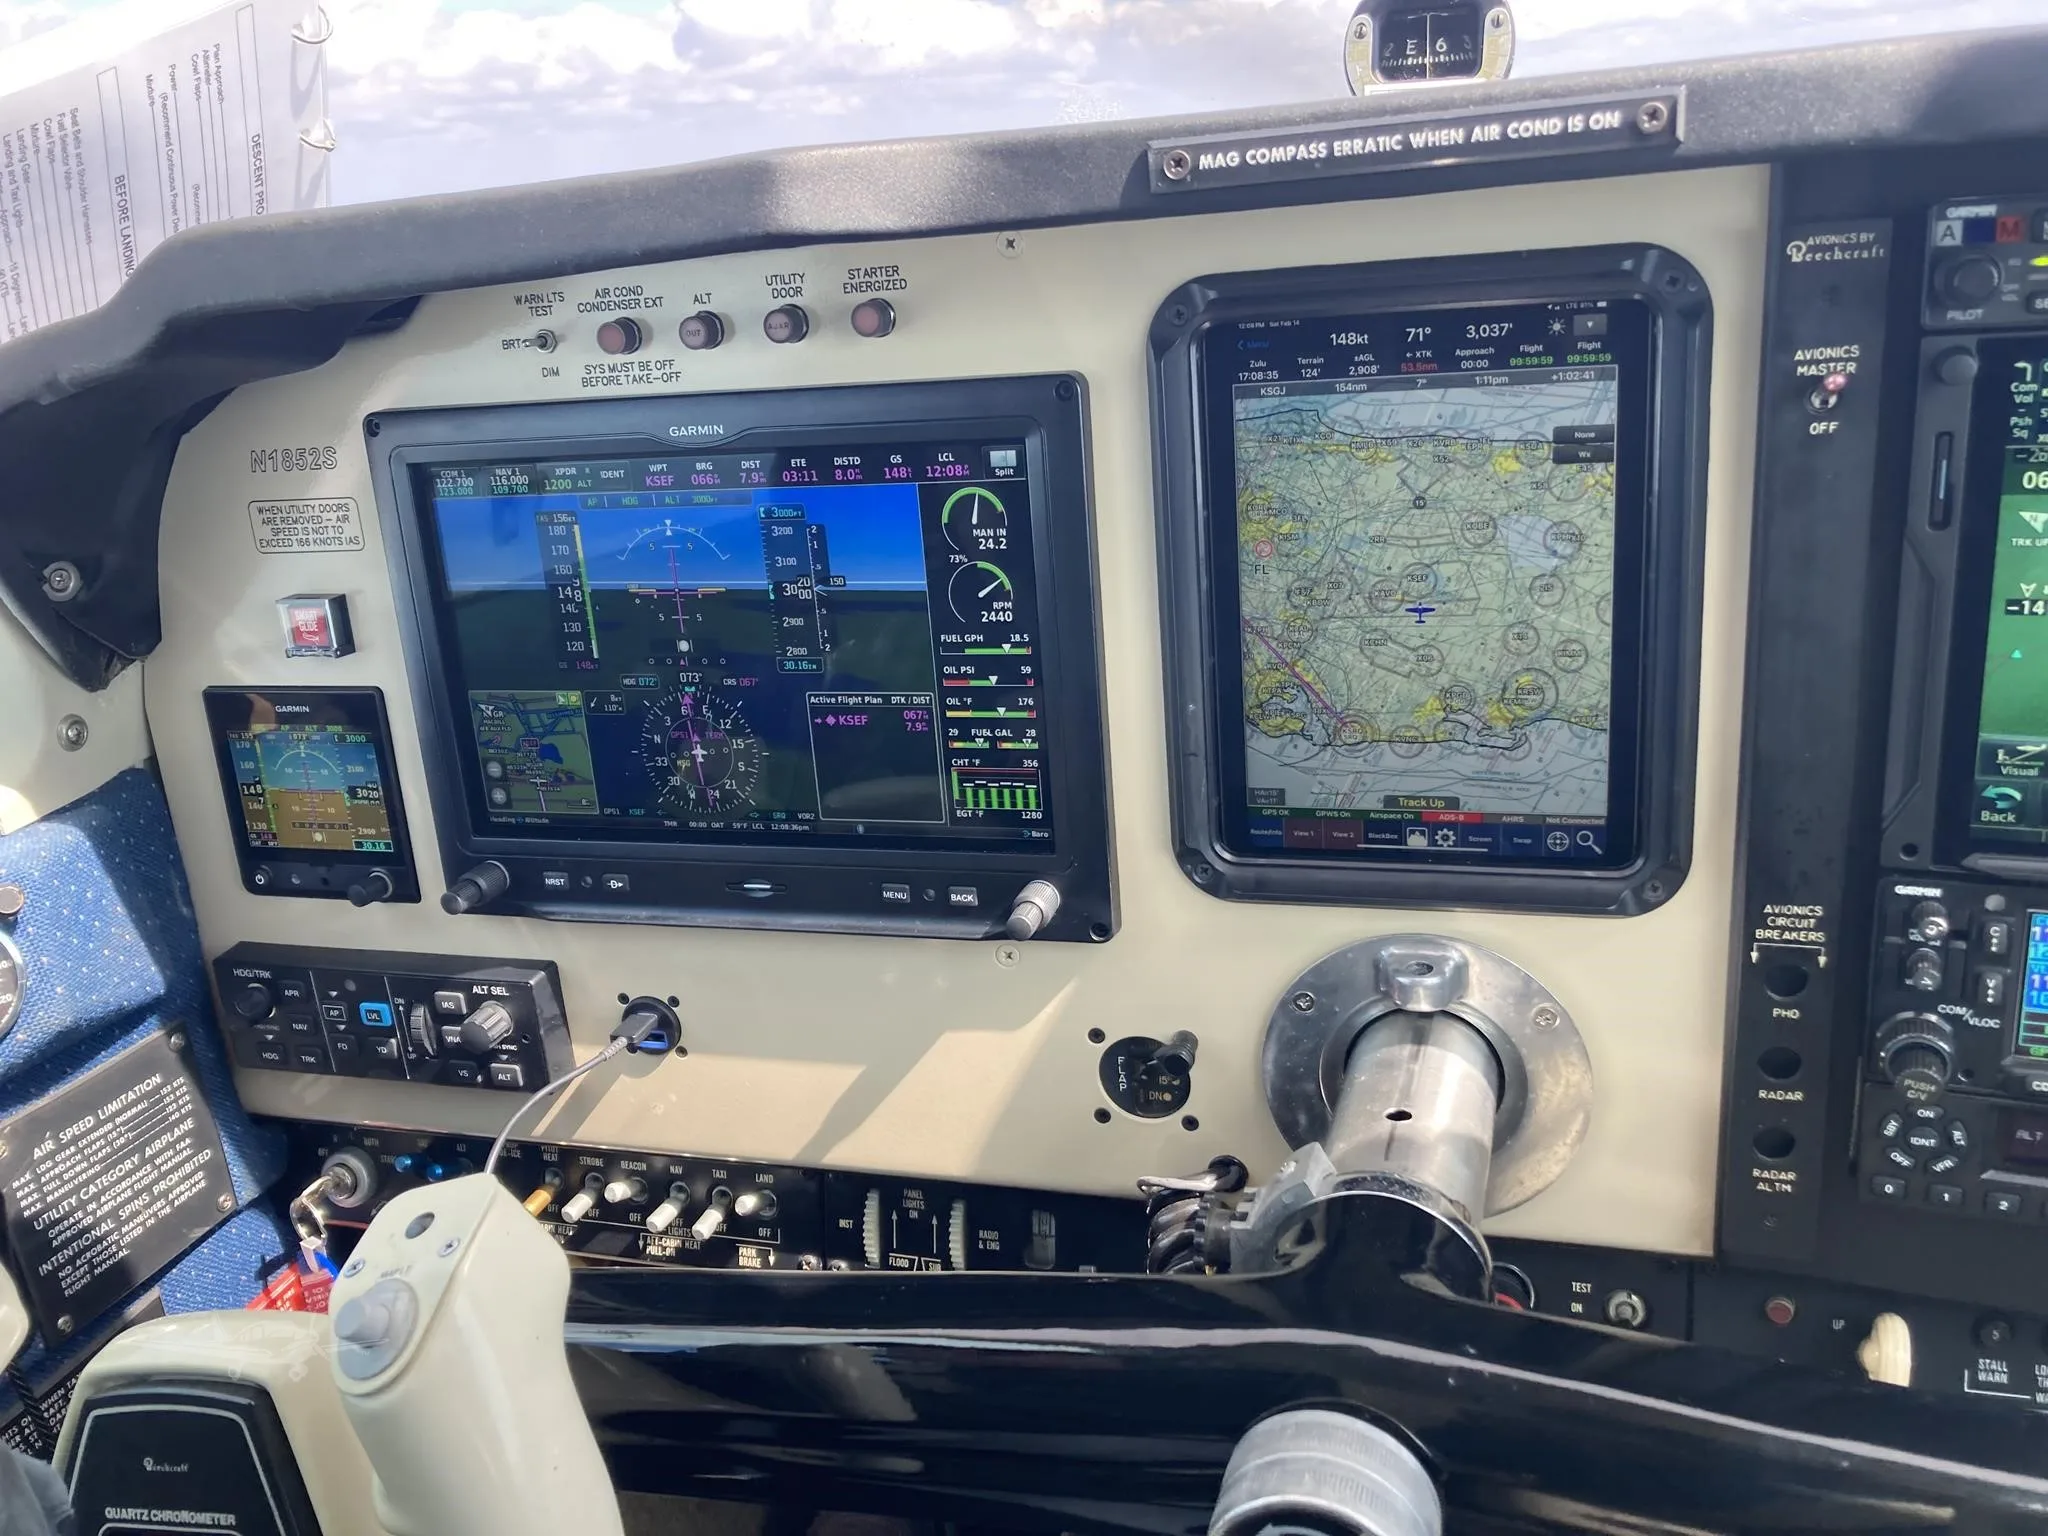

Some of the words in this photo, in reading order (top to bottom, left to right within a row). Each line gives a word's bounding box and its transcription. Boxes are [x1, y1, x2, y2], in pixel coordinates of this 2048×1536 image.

[1406, 40, 1418, 55] E
[1436, 37, 1448, 51] 6
[1199, 152, 1239, 170] MAG
[1245, 141, 1328, 165] COMPASS
[1333, 134, 1403, 156] ERRATIC
[1409, 127, 1464, 149] WHEN
[1471, 123, 1500, 143] AIR
[1507, 117, 1563, 139] COND
[1567, 114, 1584, 133] IS
[1589, 110, 1621, 130] ON
[251, 133, 264, 187] DESCENT
[114, 174, 130, 223] BEFORE
[1807, 233, 1857, 246] AVIONICS
[1859, 233, 1875, 243] BY
[1786, 240, 1885, 263] Beechcraft
[848, 265, 900, 280] STARTER
[765, 273, 805, 286] UTILITY
[595, 288, 611, 299] AIR
[614, 286, 643, 297] COND
[843, 279, 907, 294] ENERGIZED
[514, 294, 544, 305] WARN
[547, 292, 564, 303] LTS
[693, 293, 711, 304] ALT
[772, 287, 803, 299] DOOR
[529, 305, 553, 317] TEST
[577, 299, 642, 313] CONDENSER
[645, 297, 663, 308] EXT
[1947, 309, 1984, 320] PILOT
[1406, 328, 1431, 342] 71°
[1466, 323, 1513, 340] 3,037'
[502, 338, 521, 350] BRT
[1330, 332, 1369, 346] 148kt
[1455, 346, 1495, 357] Approach
[1520, 344, 1543, 353] Flight
[1577, 341, 1601, 350] Flight
[1567, 353, 1612, 364] 99:59:59
[1794, 345, 1860, 361] AVIONICS
[1297, 356, 1324, 365] Terrain
[1509, 356, 1553, 366] 99:59:59
[542, 367, 560, 378] DIM
[585, 364, 605, 375] SYS
[608, 362, 635, 373] MUST
[639, 361, 652, 372] BE
[655, 360, 675, 371] OFF
[1797, 362, 1857, 377] MASTER
[582, 375, 622, 388] BEFORE
[626, 372, 682, 385] TAKE-OFF
[1238, 371, 1279, 381] 17:08:35
[669, 426, 724, 437] GARMIN
[1809, 422, 1839, 436] OFF
[251, 446, 338, 473] N1852S
[791, 458, 807, 468] ETE
[834, 456, 861, 467] DISTD
[938, 453, 954, 462] LCL
[649, 464, 668, 473] WPT
[696, 462, 713, 471] BRG
[741, 460, 761, 469] DIST
[783, 470, 818, 483] 03:11
[994, 467, 1014, 477] Split
[490, 475, 529, 486] 116.000
[645, 476, 675, 487] KSEF
[257, 506, 283, 515] WHEN
[285, 505, 315, 515] UTILITY
[319, 503, 350, 513] DOORS
[261, 517, 278, 526] ARE
[280, 515, 323, 526] REMOVED
[336, 514, 350, 524] AIR
[271, 527, 299, 537] SPEED
[301, 527, 310, 536] IS
[312, 526, 330, 536] NOT
[332, 526, 344, 536] TO
[259, 538, 293, 548] EXCEED
[296, 537, 311, 547] 166
[313, 537, 343, 547] KNOTS
[346, 536, 360, 545] IAS
[978, 538, 1007, 550] 24.2
[949, 554, 968, 564] 73%
[993, 601, 1013, 610] RPM
[981, 611, 1013, 623] 2440
[941, 634, 963, 643] FUEL
[965, 634, 983, 643] GPH
[1010, 634, 1029, 643] 18.5
[944, 666, 958, 675] OIL
[960, 666, 975, 675] PSI
[1020, 665, 1032, 674] 59
[809, 696, 835, 704] Active
[837, 696, 862, 706] Flight
[863, 696, 883, 705] Plan
[946, 697, 961, 705] OIL
[1018, 697, 1034, 705] 176
[275, 705, 309, 713] GARMIN
[839, 715, 869, 726] KSEF
[951, 758, 969, 767] CHT
[1022, 759, 1039, 768] 356
[2001, 765, 2039, 776] Visual
[1397, 797, 1427, 807] Track
[1430, 799, 1445, 809] Up
[956, 810, 972, 818] EGT
[1021, 811, 1043, 820] 1280
[1369, 812, 1401, 821] Airspace
[1981, 810, 2016, 822] Back
[545, 878, 564, 887] NRST
[883, 891, 907, 900] MENU
[1895, 886, 1943, 897] GARMIN
[951, 893, 973, 903] BACK
[1763, 904, 1824, 917] AVIONICS
[1767, 917, 1816, 929] CIRCUIT
[1755, 929, 1825, 943] BREAKERS
[233, 968, 273, 979] HDG/TRK
[472, 985, 489, 995] ALT
[491, 987, 509, 996] SEL
[367, 1012, 381, 1020] LVL
[1117, 1056, 1127, 1092] FLAP
[1758, 1089, 1804, 1101] RADAR
[33, 1140, 56, 1160] AIR
[58, 1115, 94, 1143] SPEED
[97, 1073, 162, 1120] LIMITATION
[1911, 1136, 1937, 1148] IDNT
[580, 1156, 604, 1167] STROBE
[620, 1161, 647, 1171] BEACON
[33, 1195, 77, 1231] UTILITY
[80, 1153, 139, 1200] CATEGORY
[145, 1117, 195, 1158] AIRPLANE
[670, 1166, 683, 1175] NAV
[712, 1169, 727, 1179] TAXI
[1752, 1168, 1797, 1181] RADAR
[755, 1173, 773, 1183] LAND
[48, 1210, 83, 1238] OPERATE
[86, 1201, 97, 1213] IN
[100, 1163, 152, 1204] ACCORDANCE
[153, 1149, 174, 1166] WITH
[175, 1138, 192, 1152] FAA
[1756, 1181, 1792, 1193] ALTM
[903, 1189, 923, 1200] PANEL
[903, 1199, 925, 1210] LIGHTS
[38, 1218, 116, 1277] INTENTIONAL
[118, 1192, 150, 1220] SPINS
[152, 1149, 211, 1196] PROHIBITED
[738, 1247, 757, 1257] PARK
[738, 1256, 761, 1268] BRAKE
[1571, 1281, 1592, 1294] TEST
[1570, 1302, 1583, 1313] ON
[1978, 1358, 2008, 1372] STALL
[1977, 1370, 2009, 1385] WARN
[105, 1506, 149, 1520] QUARTZ
[150, 1509, 236, 1526] CHRONOMETER
